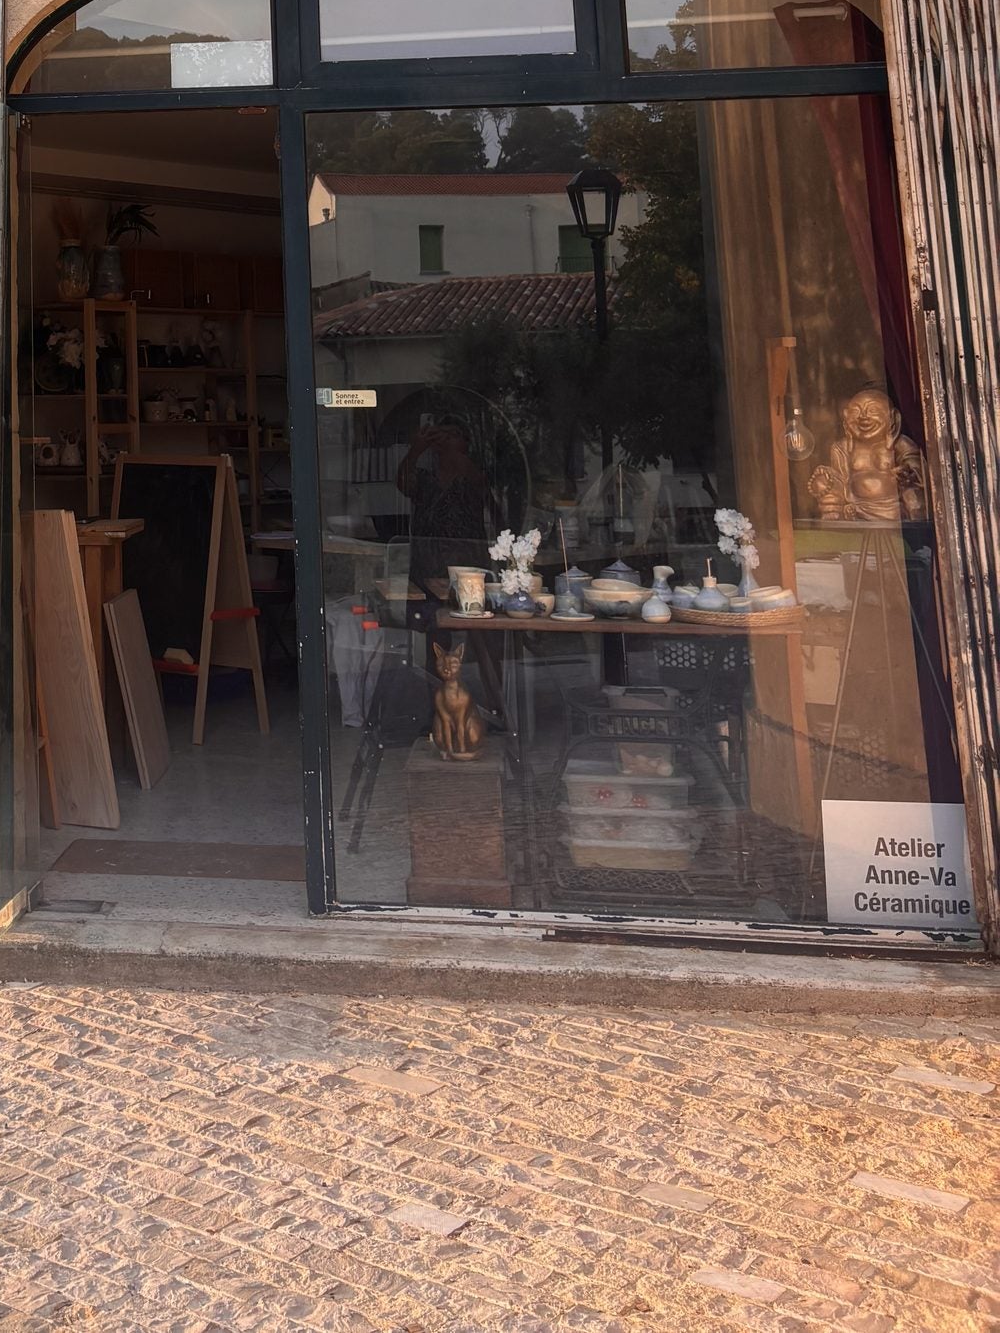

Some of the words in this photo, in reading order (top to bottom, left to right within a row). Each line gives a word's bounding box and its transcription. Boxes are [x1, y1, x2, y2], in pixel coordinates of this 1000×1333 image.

[874, 836, 946, 859] Atelier
[864, 864, 958, 887] Anne-Va
[853, 891, 971, 919] Céramique
